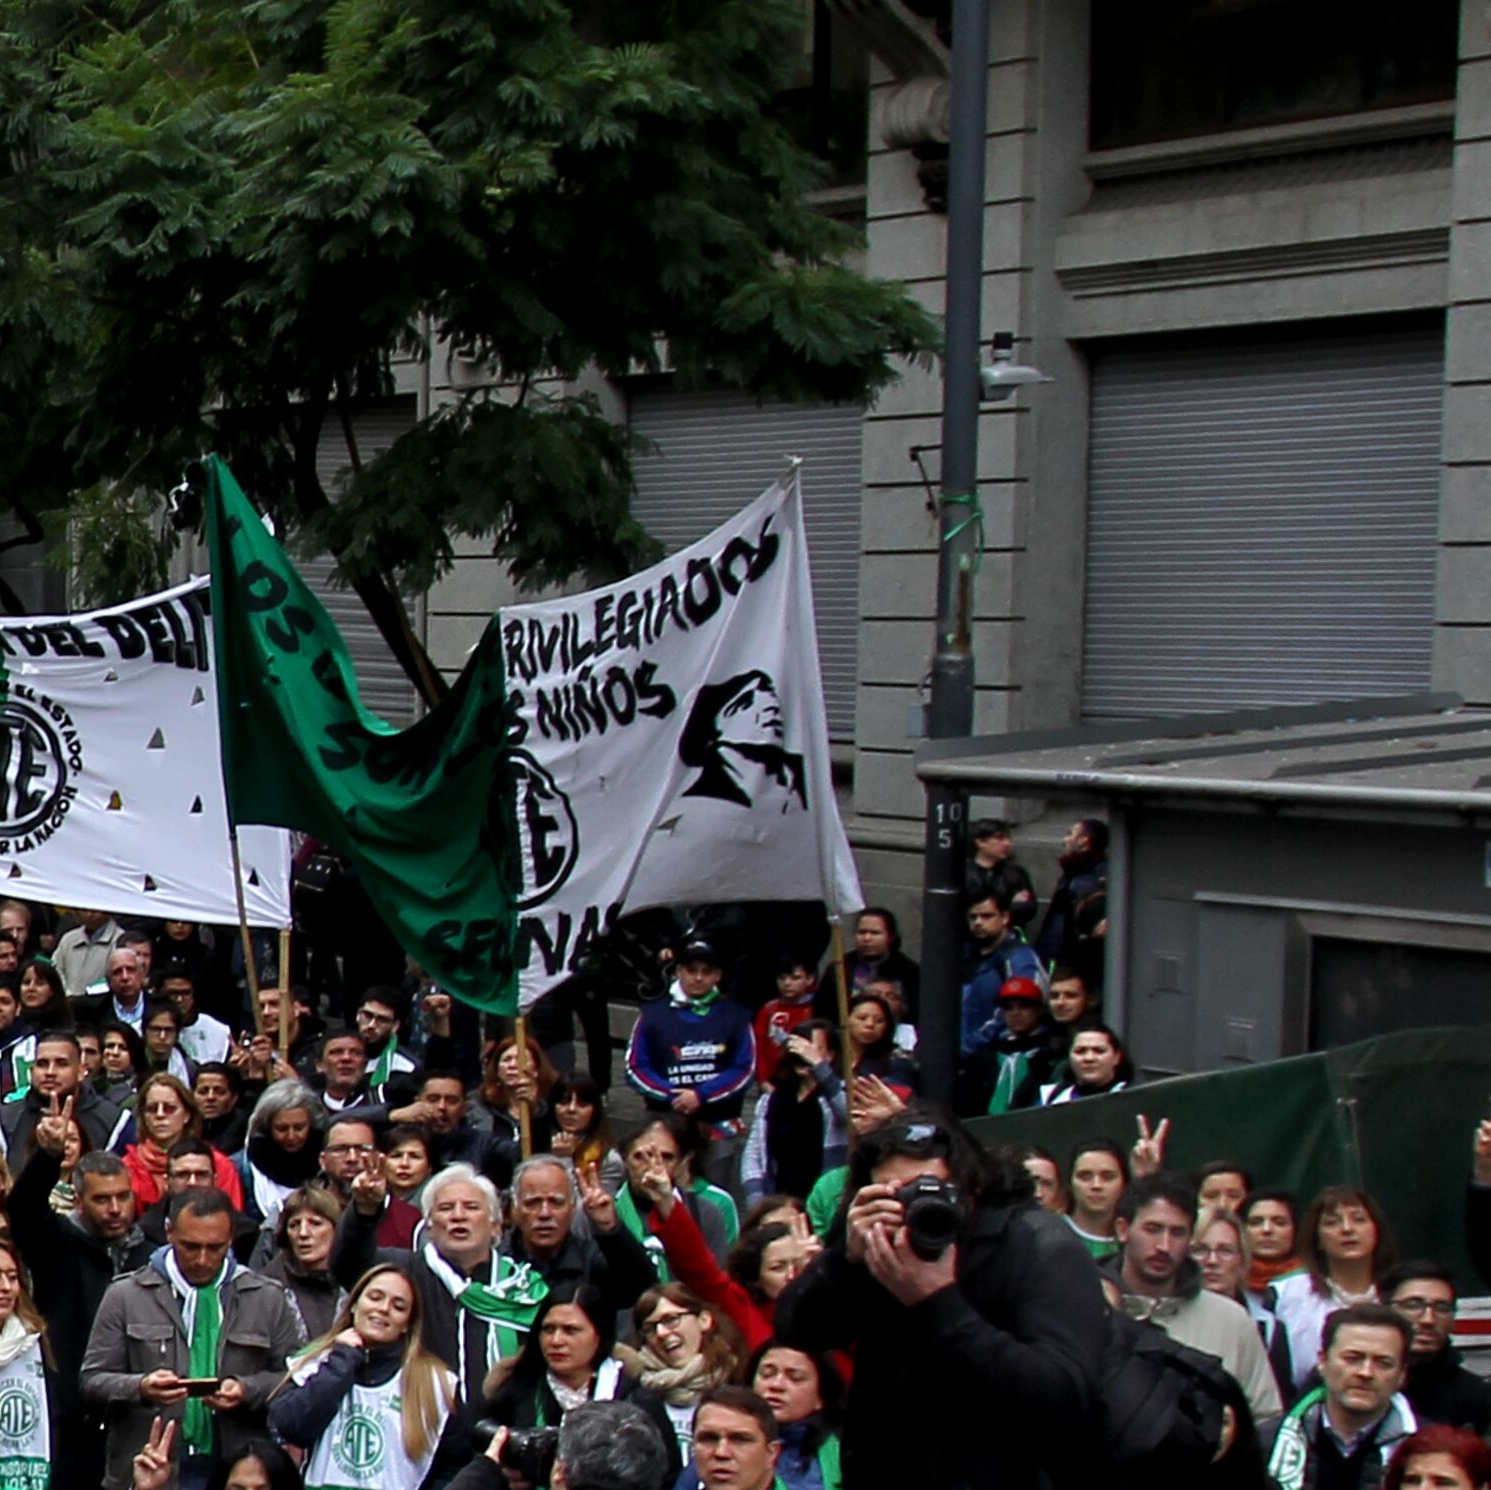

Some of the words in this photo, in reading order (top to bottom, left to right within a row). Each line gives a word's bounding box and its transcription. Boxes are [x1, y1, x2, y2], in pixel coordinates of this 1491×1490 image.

[19, 625, 104, 658] DEL
[93, 594, 210, 671] DELI
[15, 684, 36, 701] EL
[536, 660, 676, 741] NIÑOS
[16, 835, 35, 852] LA
[0, 1397, 32, 1433] ATE
[344, 1423, 377, 1464] ATE
